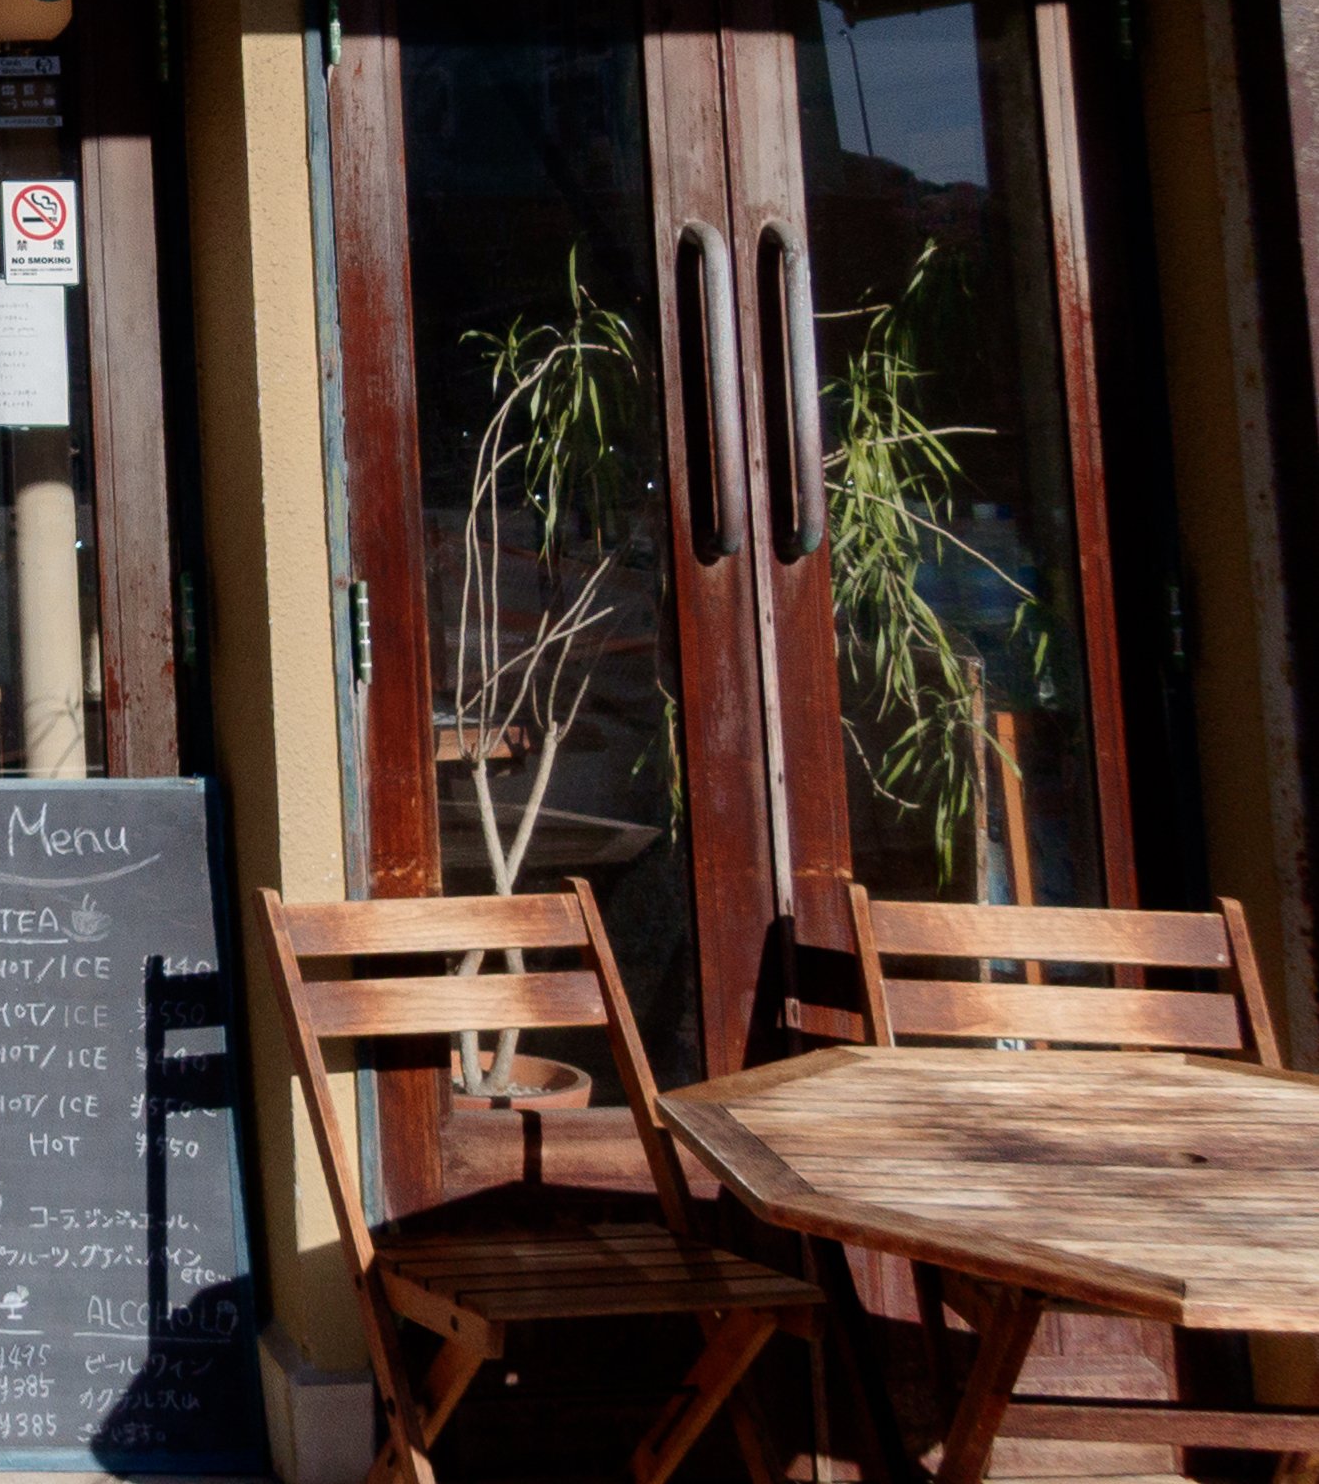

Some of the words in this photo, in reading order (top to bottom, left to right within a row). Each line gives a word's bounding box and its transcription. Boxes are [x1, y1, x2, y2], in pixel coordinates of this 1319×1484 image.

[11, 256, 26, 265] NO
[27, 256, 72, 265] SMOKING
[8, 802, 132, 858] Menu
[29, 1132, 81, 1158] HOT
